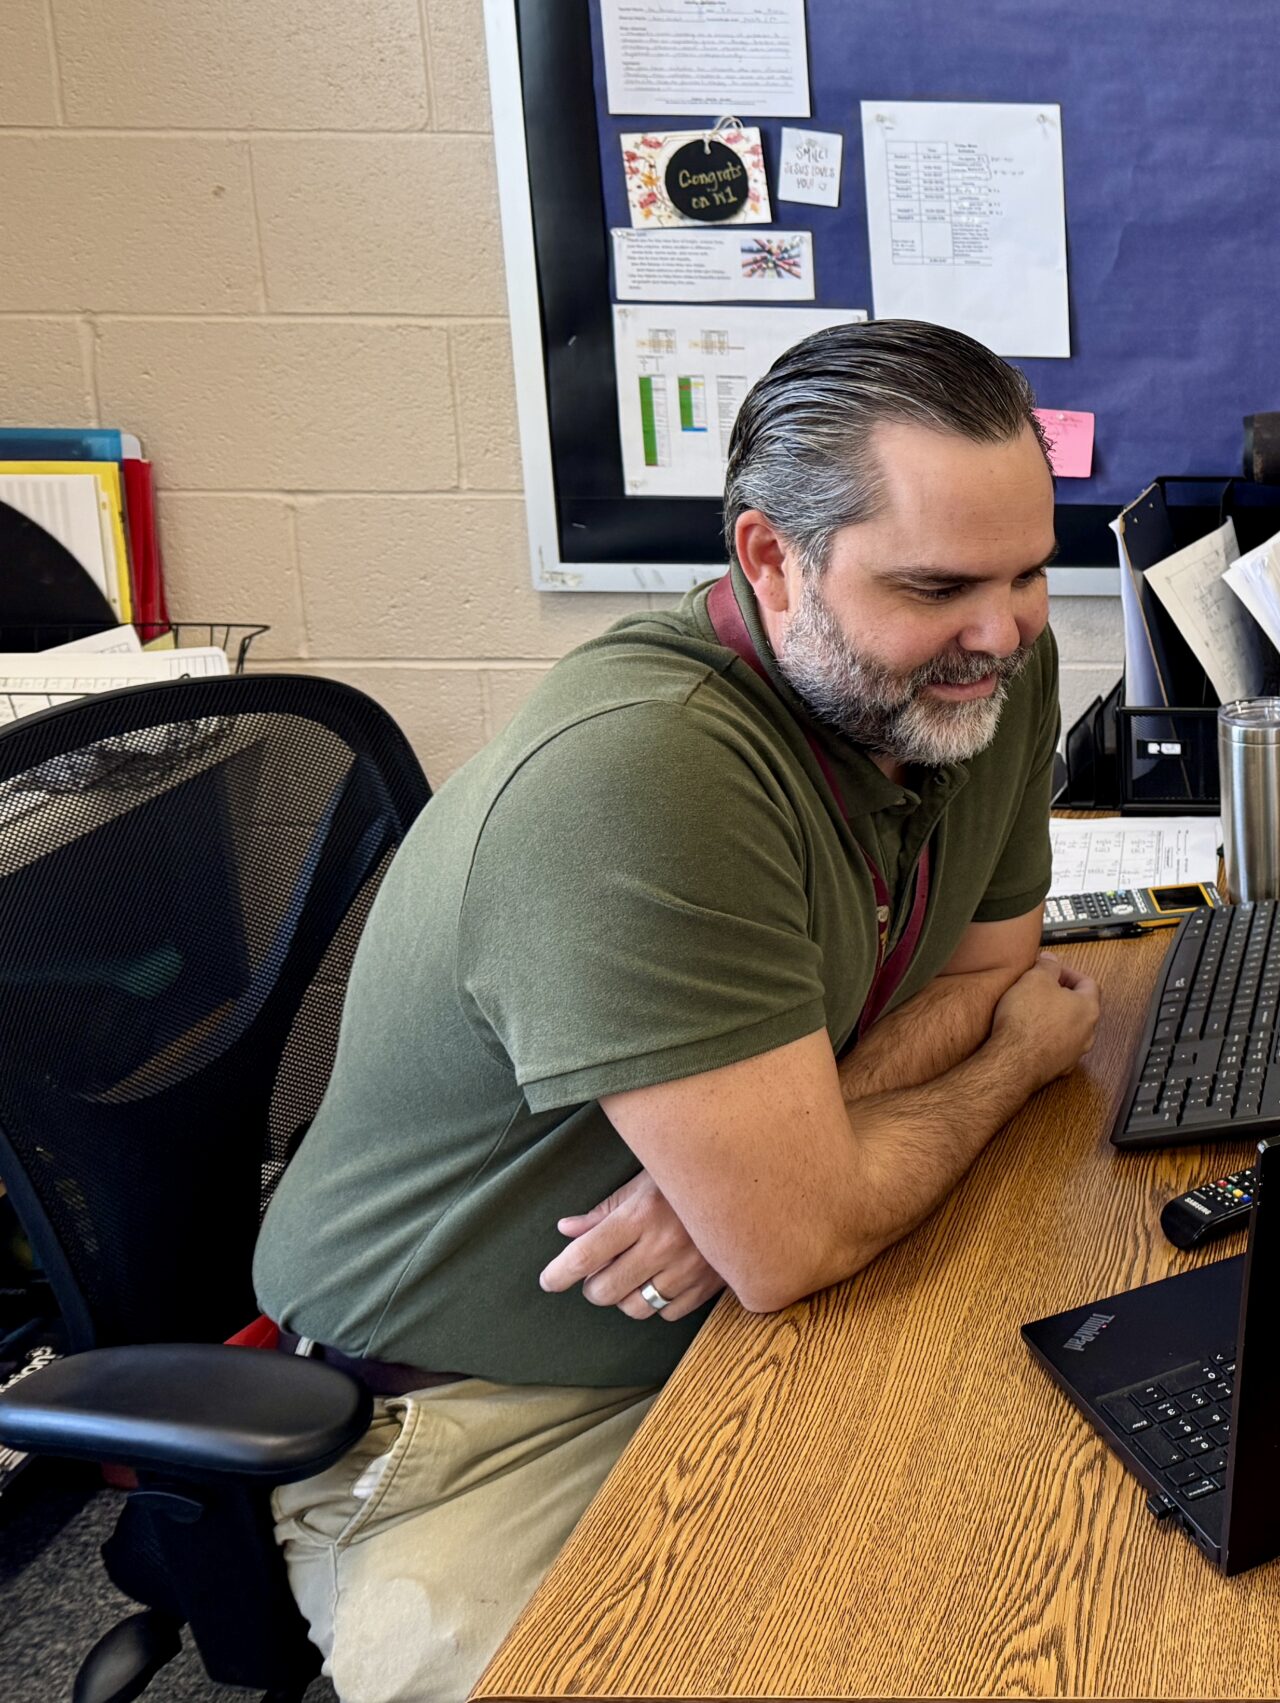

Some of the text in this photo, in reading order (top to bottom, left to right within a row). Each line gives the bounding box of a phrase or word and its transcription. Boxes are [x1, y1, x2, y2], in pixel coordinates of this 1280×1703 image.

[679, 163, 741, 192] Congrats
[690, 195, 710, 209] on
[1184, 1197, 1212, 1215] SAMSUNG
[1062, 1312, 1116, 1352] ThinkPad
